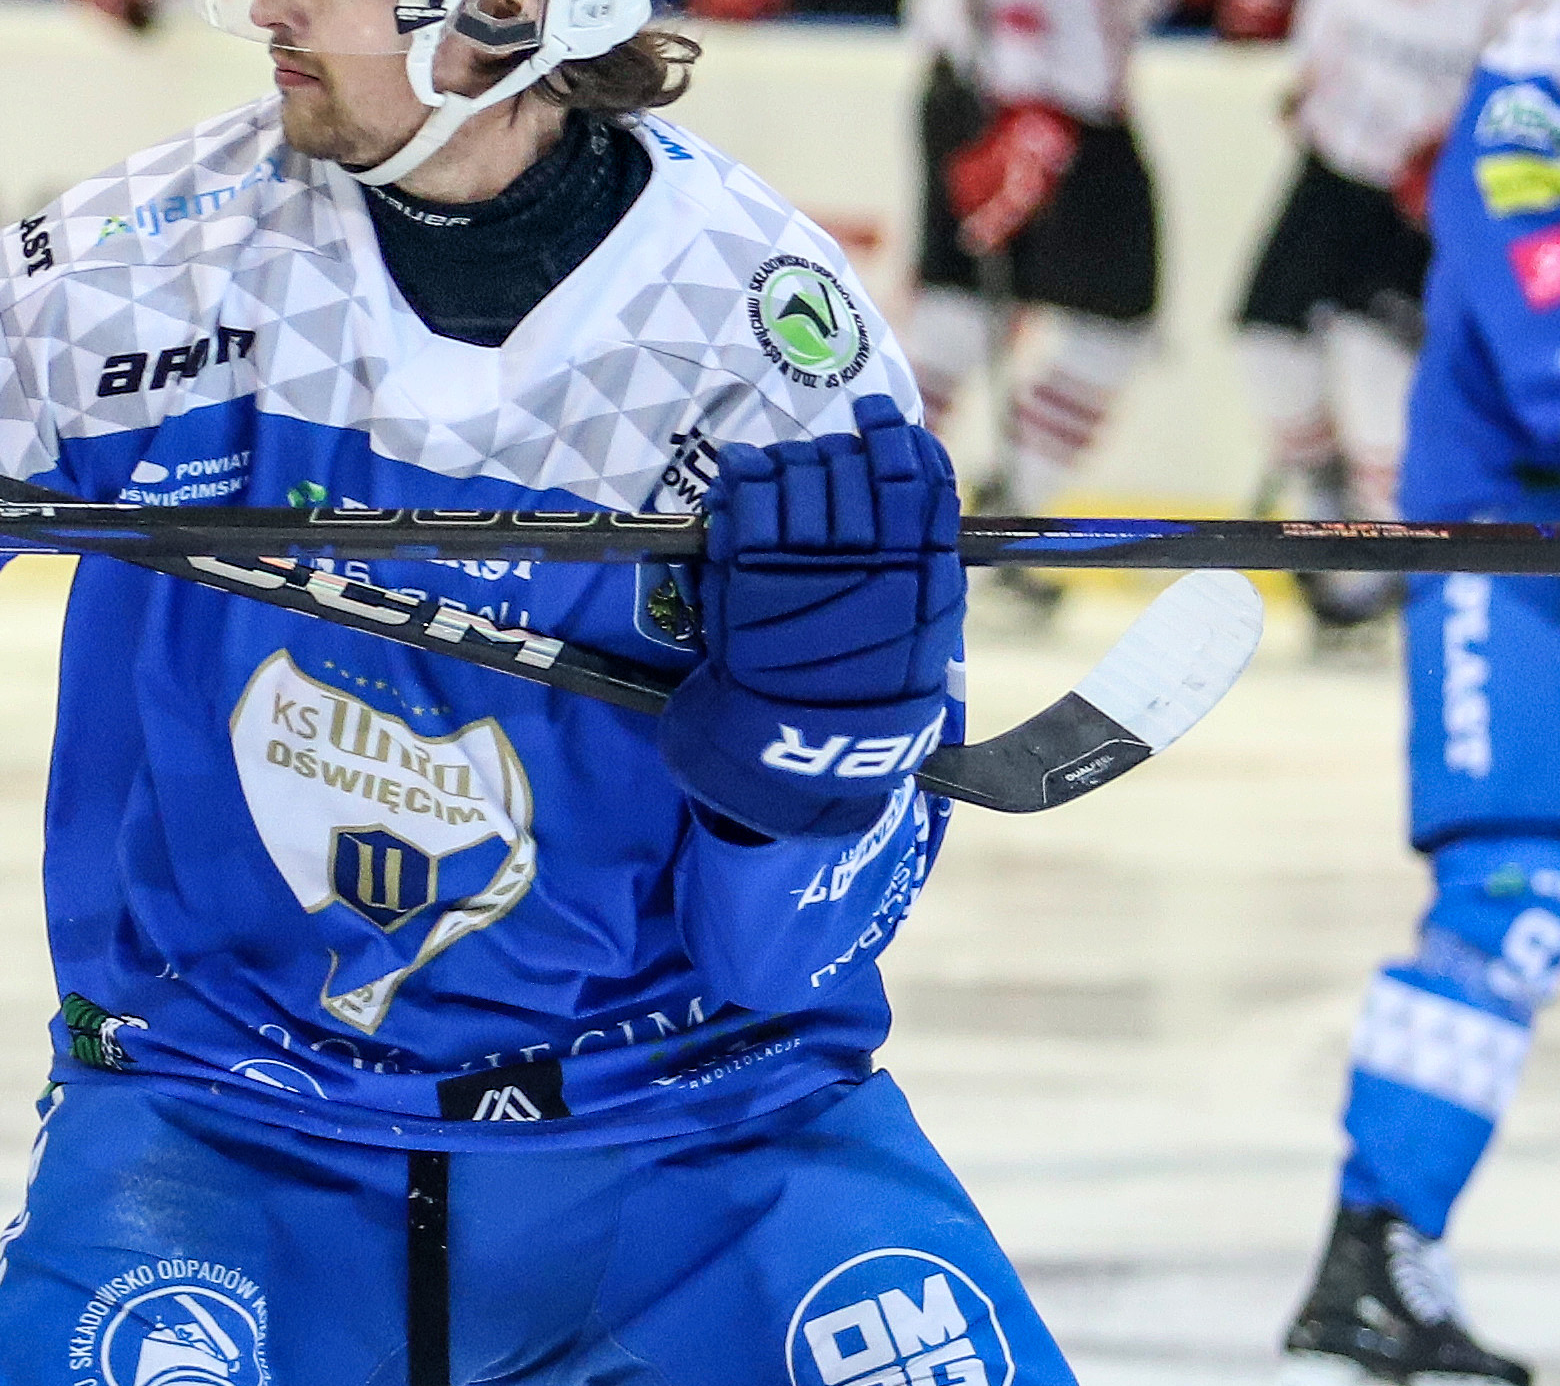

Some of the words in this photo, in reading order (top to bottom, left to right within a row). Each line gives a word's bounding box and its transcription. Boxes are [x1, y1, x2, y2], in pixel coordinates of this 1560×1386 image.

[175, 450, 254, 481] POWIAT
[271, 692, 320, 740] KS
[266, 737, 487, 826] OŚWIĘCIM
[680, 1037, 802, 1090] RMOIZOLACJE
[69, 1263, 156, 1371] SKŁADOWISKO
[157, 1258, 261, 1298] ODPADÓW
